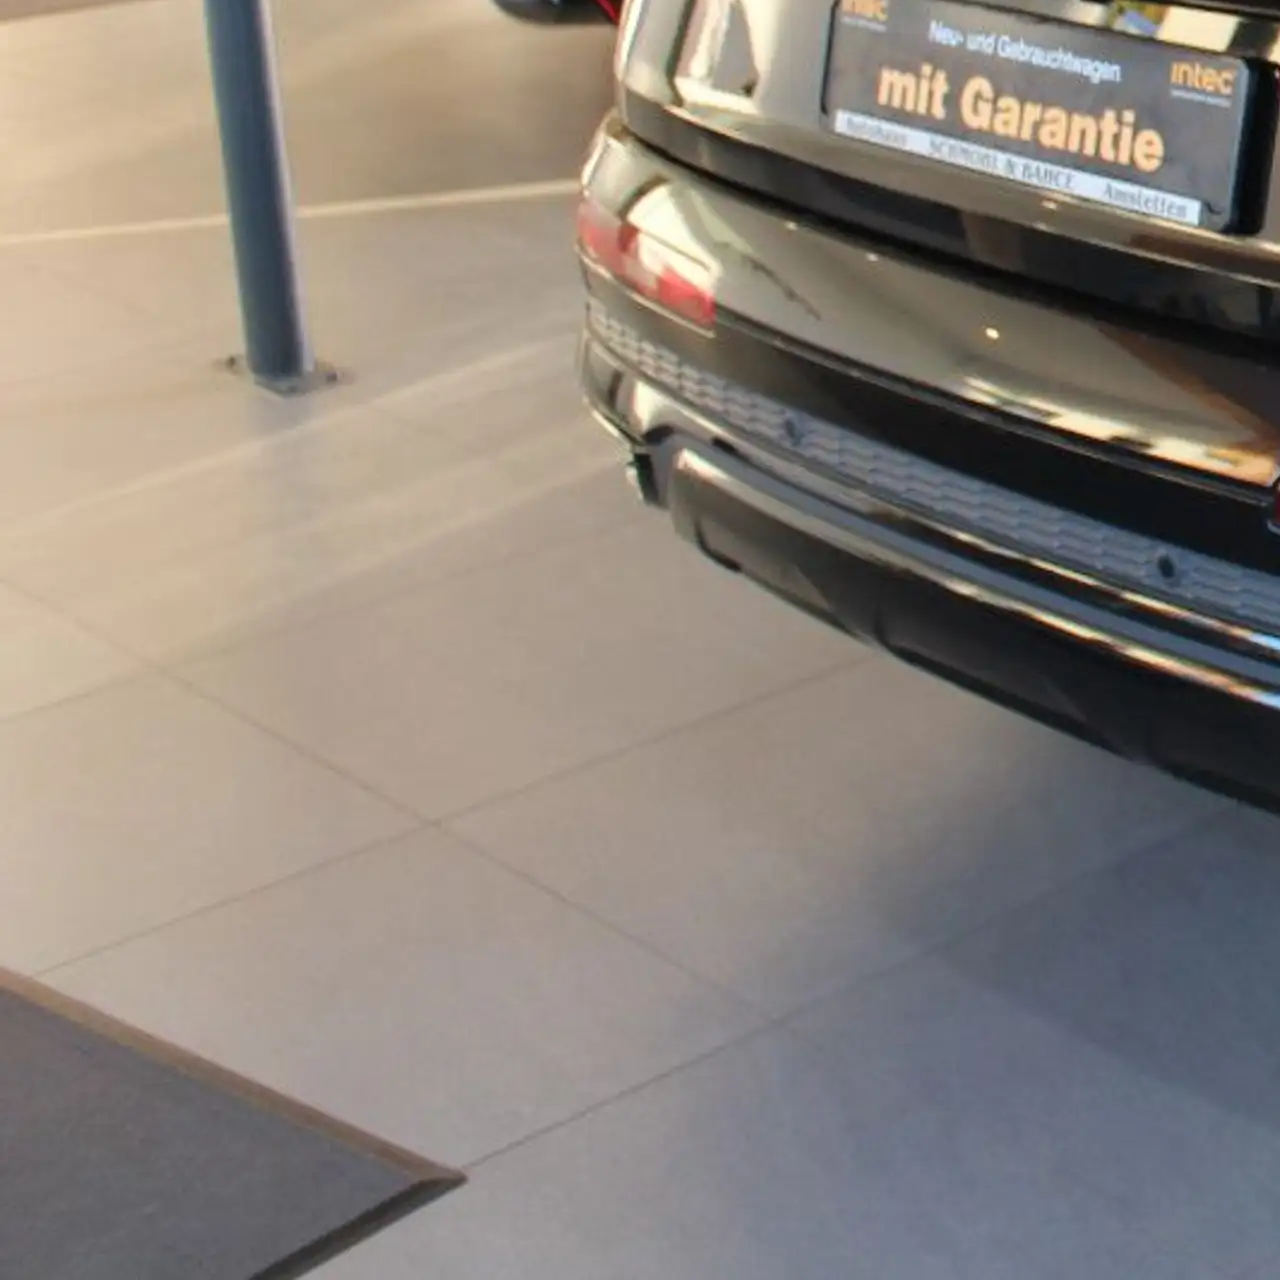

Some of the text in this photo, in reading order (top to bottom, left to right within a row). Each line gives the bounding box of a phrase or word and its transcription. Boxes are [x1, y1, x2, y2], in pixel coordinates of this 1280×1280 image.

[929, 19, 1122, 84] Neu- und Gebrauchtwagen
[877, 64, 1166, 173] mit Garantie
